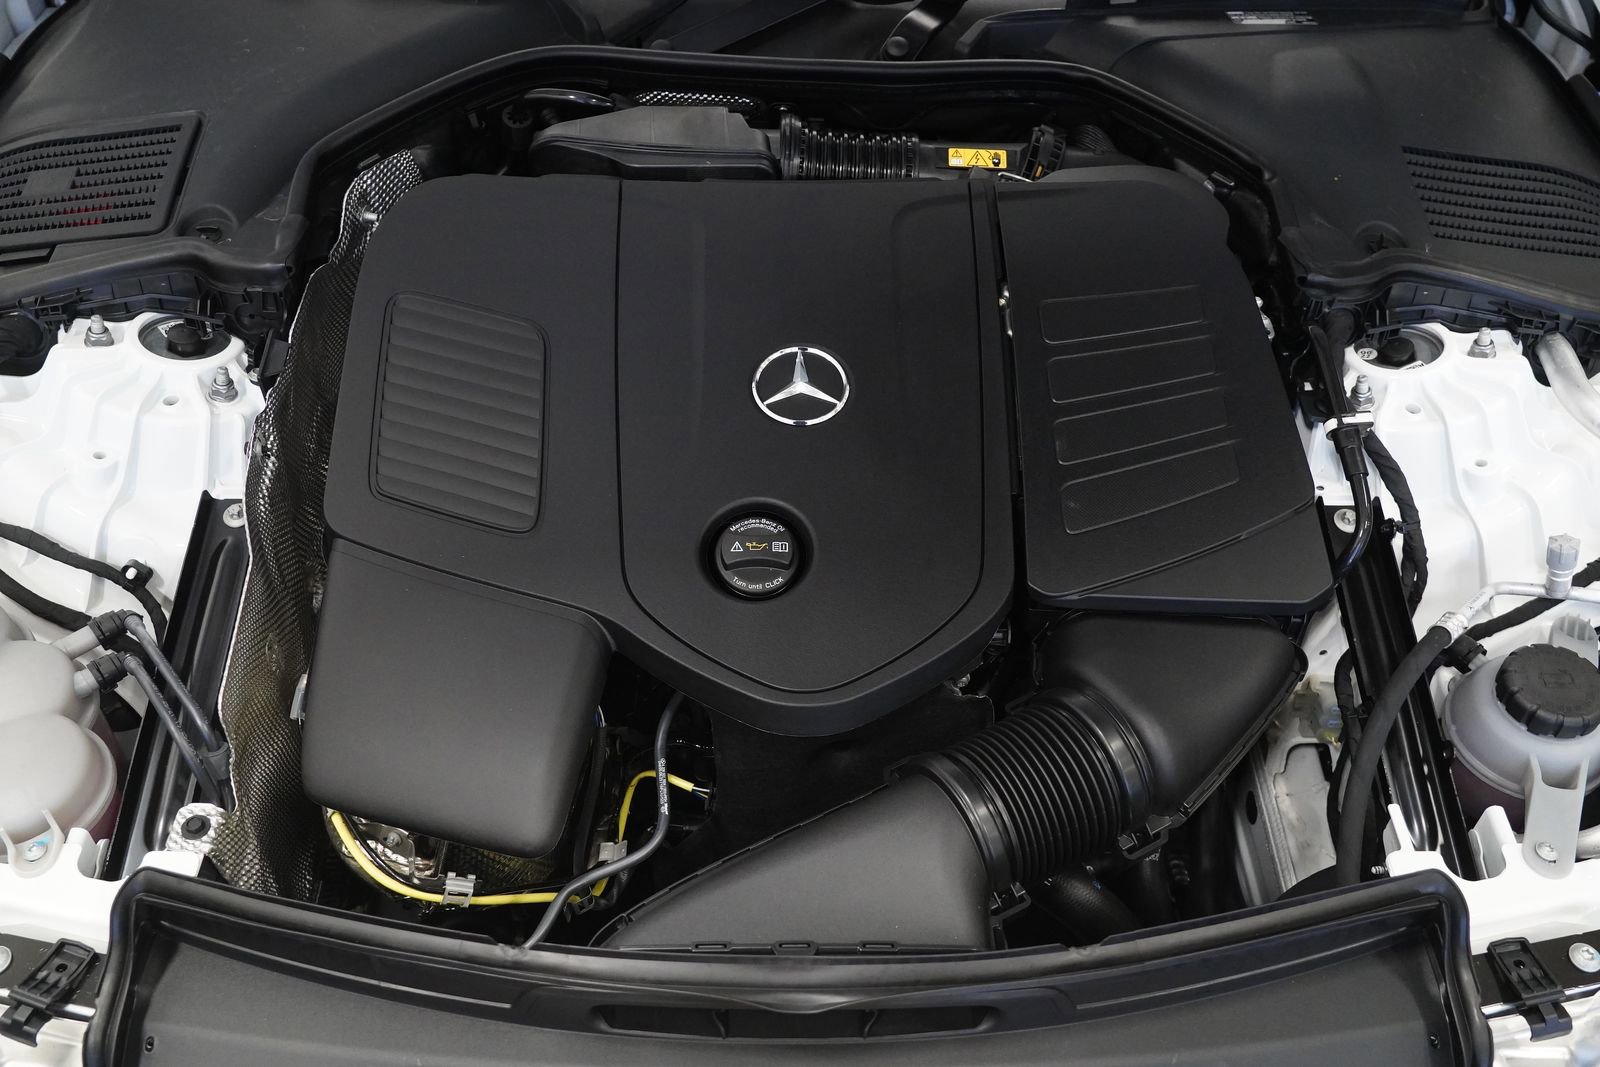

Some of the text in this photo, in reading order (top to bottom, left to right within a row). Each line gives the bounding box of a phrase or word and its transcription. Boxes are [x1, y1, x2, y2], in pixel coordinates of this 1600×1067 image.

[730, 518, 777, 531] Mercedes-Benz
[737, 523, 778, 533] recommended
[733, 576, 747, 587] Turn
[764, 576, 784, 588] CLICK
